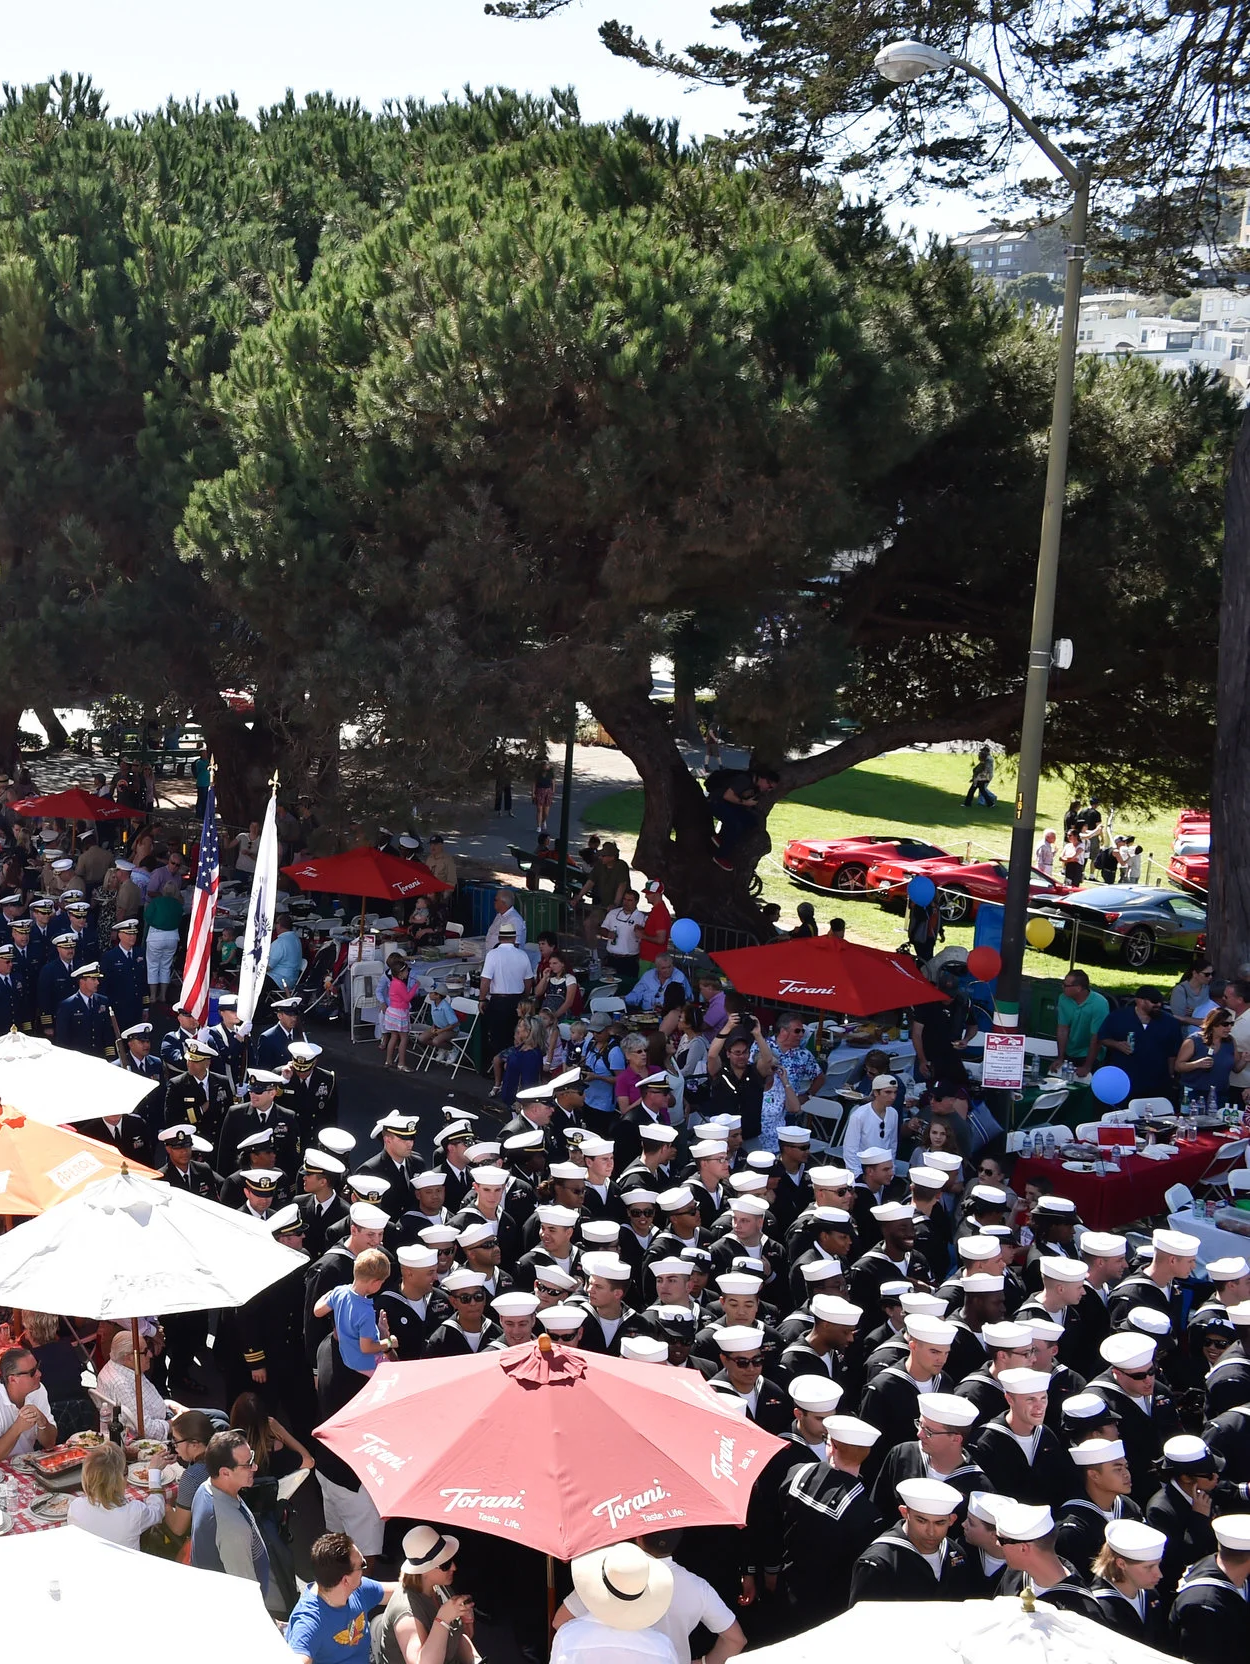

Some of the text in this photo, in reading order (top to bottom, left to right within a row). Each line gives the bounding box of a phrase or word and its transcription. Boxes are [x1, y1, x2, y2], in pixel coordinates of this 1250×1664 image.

[57, 1155, 96, 1185] APEROL
[478, 1511, 522, 1530] Taste. Life.
[640, 1508, 687, 1523] Taste. Life.
